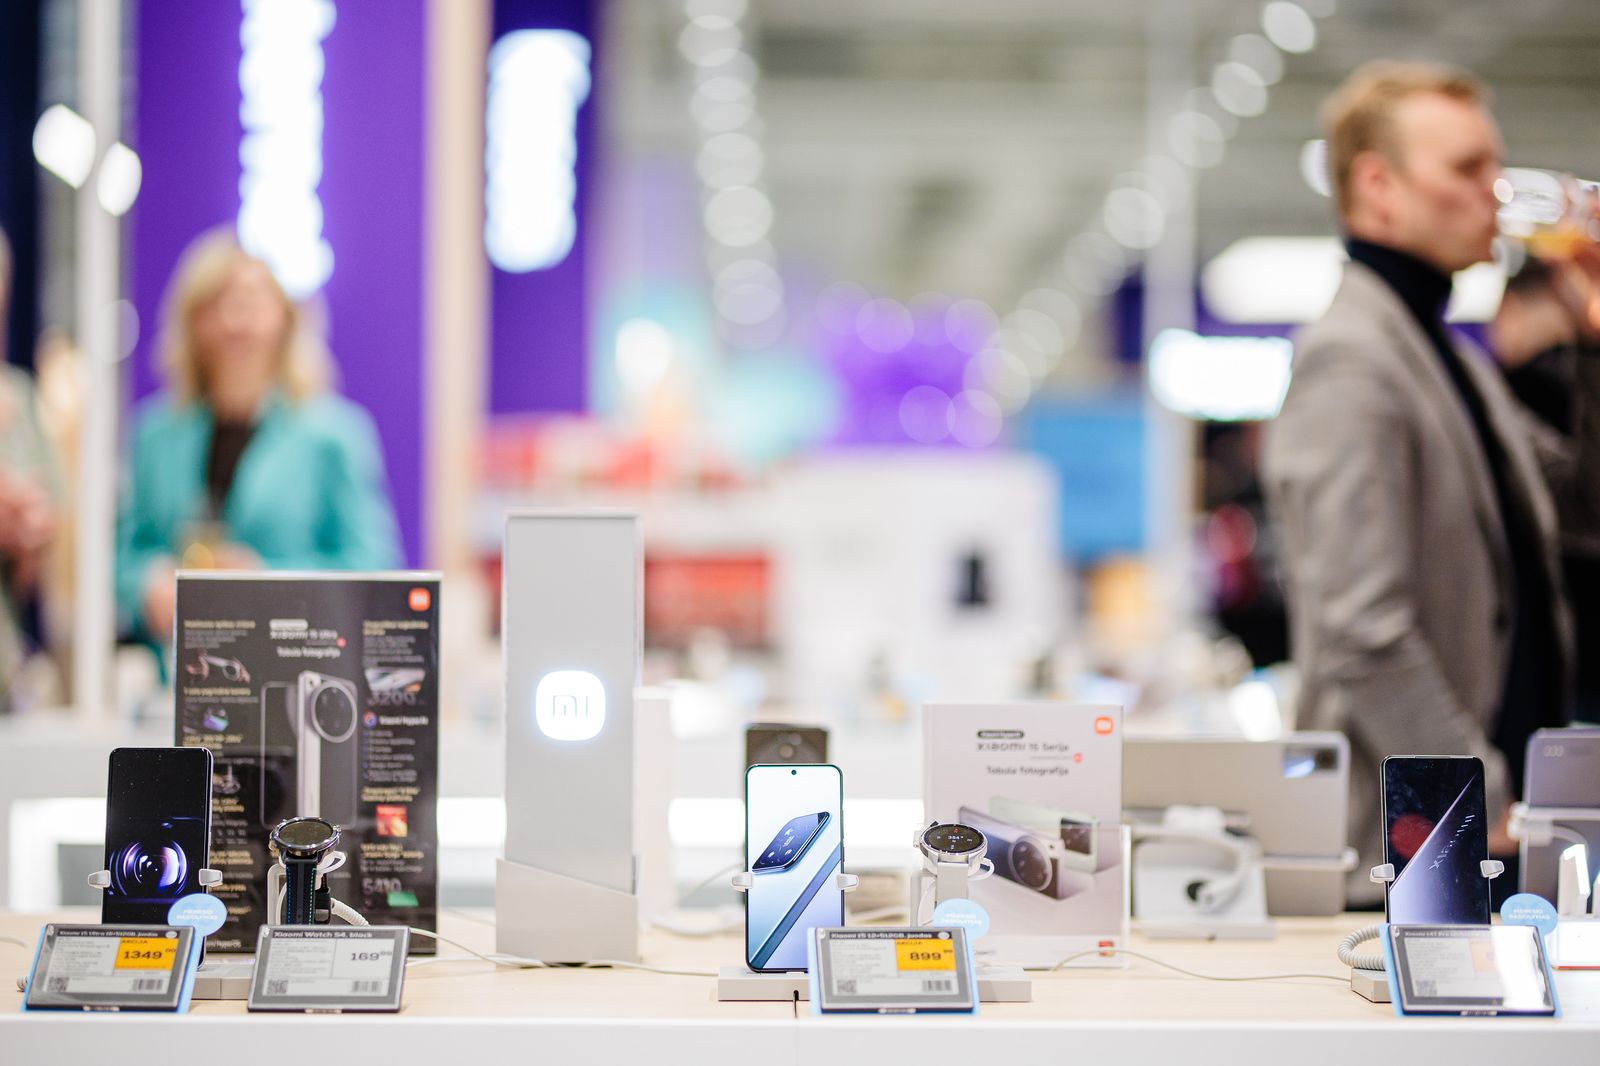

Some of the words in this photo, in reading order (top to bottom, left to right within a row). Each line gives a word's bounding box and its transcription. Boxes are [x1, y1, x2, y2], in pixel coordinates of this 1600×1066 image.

[986, 765, 1017, 775] Tobula
[1019, 765, 1069, 778] fotografija
[123, 950, 163, 960] 1349
[350, 952, 380, 961] 169
[909, 952, 942, 961] 899
